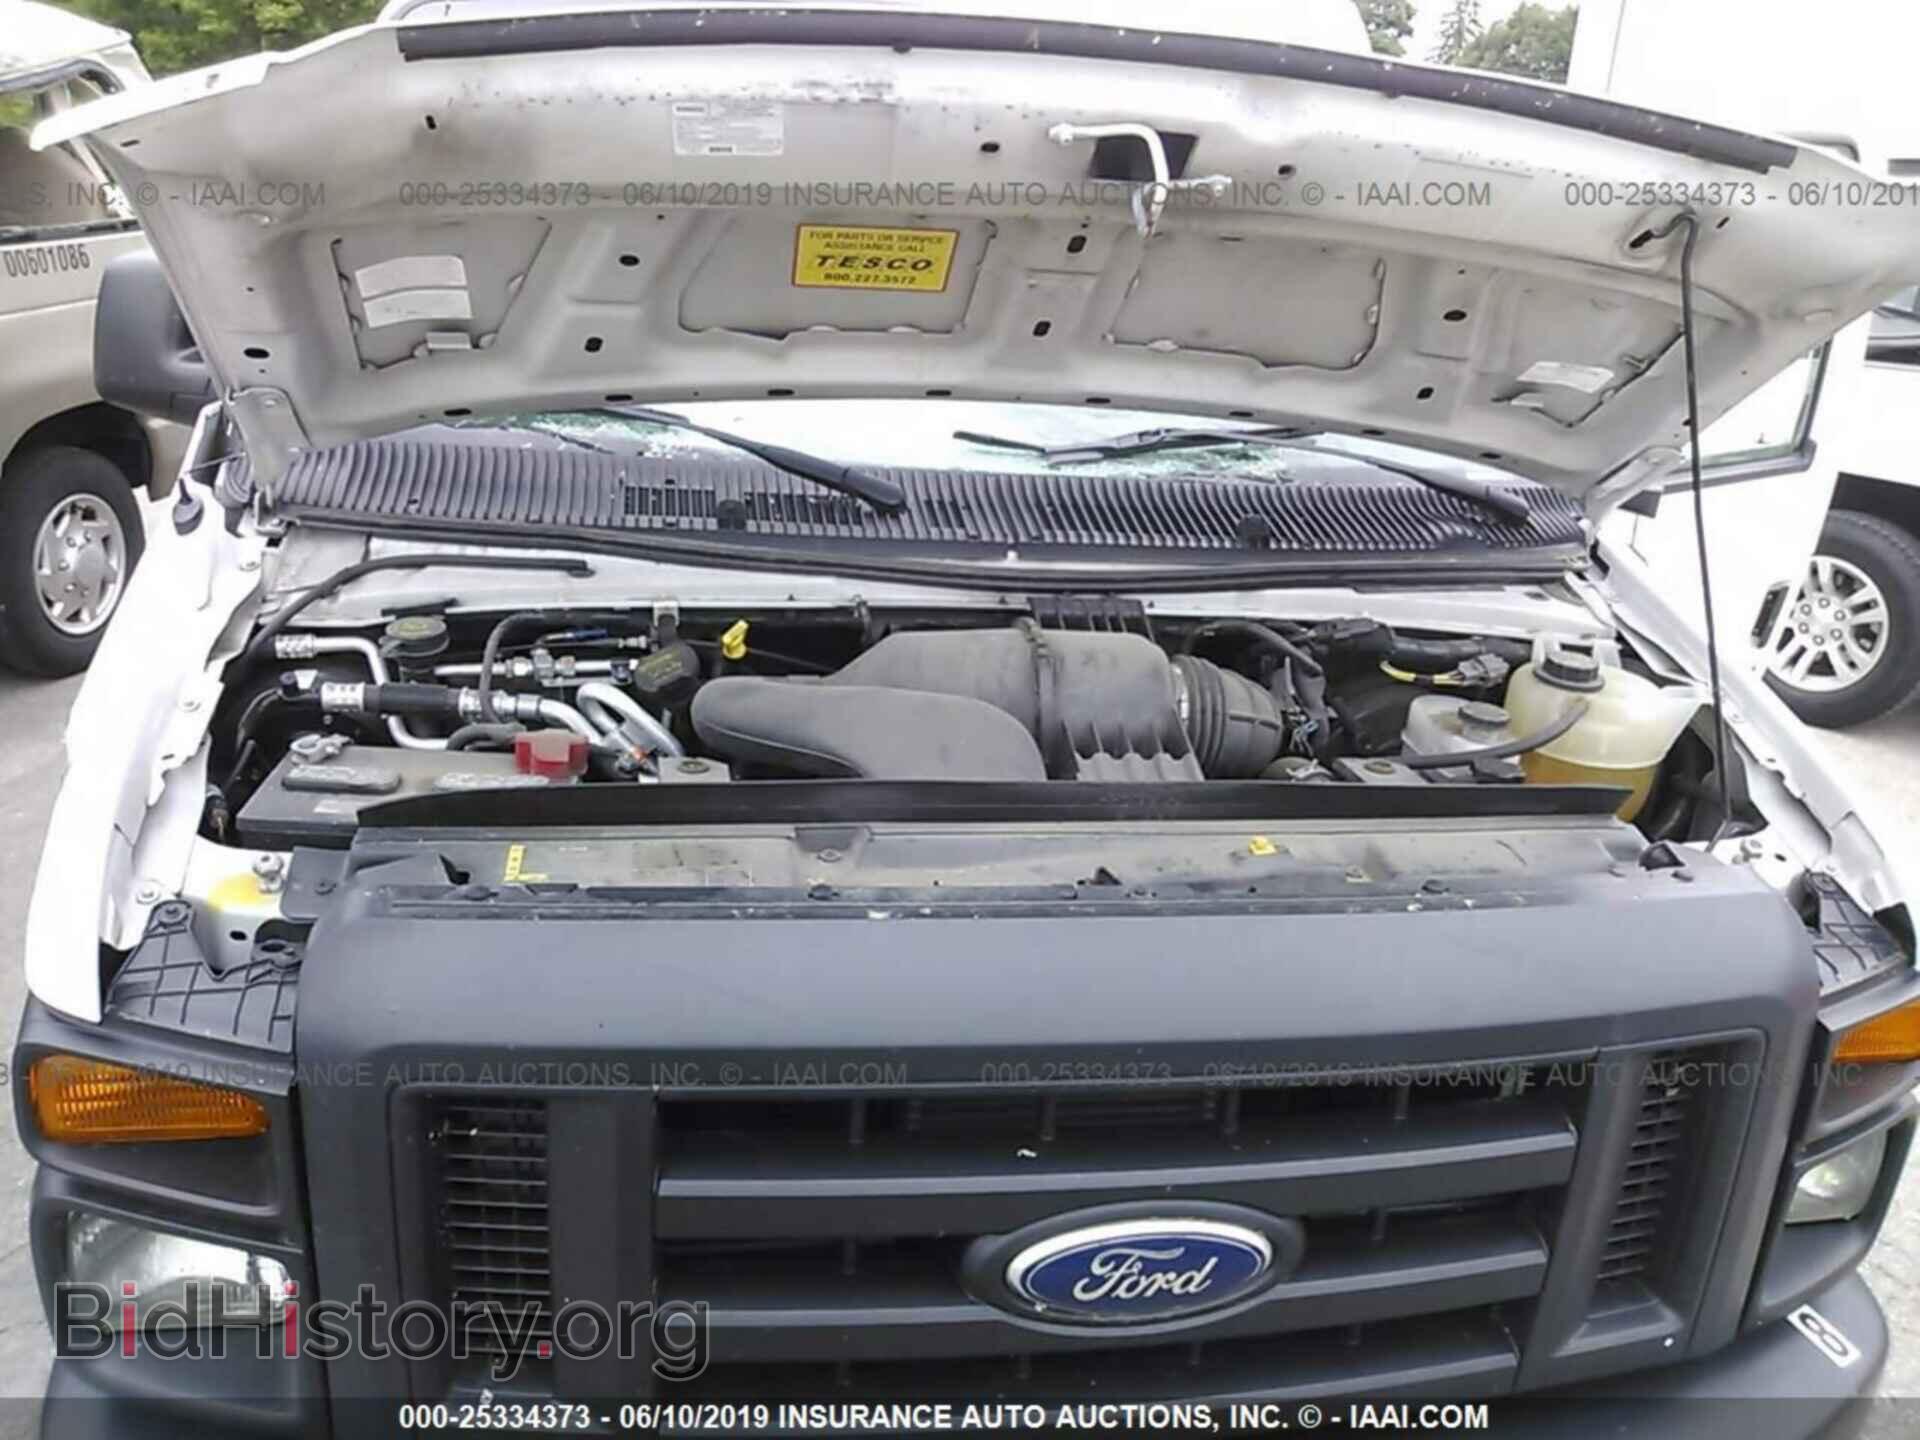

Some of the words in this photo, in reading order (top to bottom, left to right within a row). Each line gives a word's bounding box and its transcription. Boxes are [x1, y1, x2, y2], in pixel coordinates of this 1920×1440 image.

[3, 243, 91, 278] 00601086
[815, 254, 933, 272] TESCO
[1071, 1246, 1219, 1301] Ford
